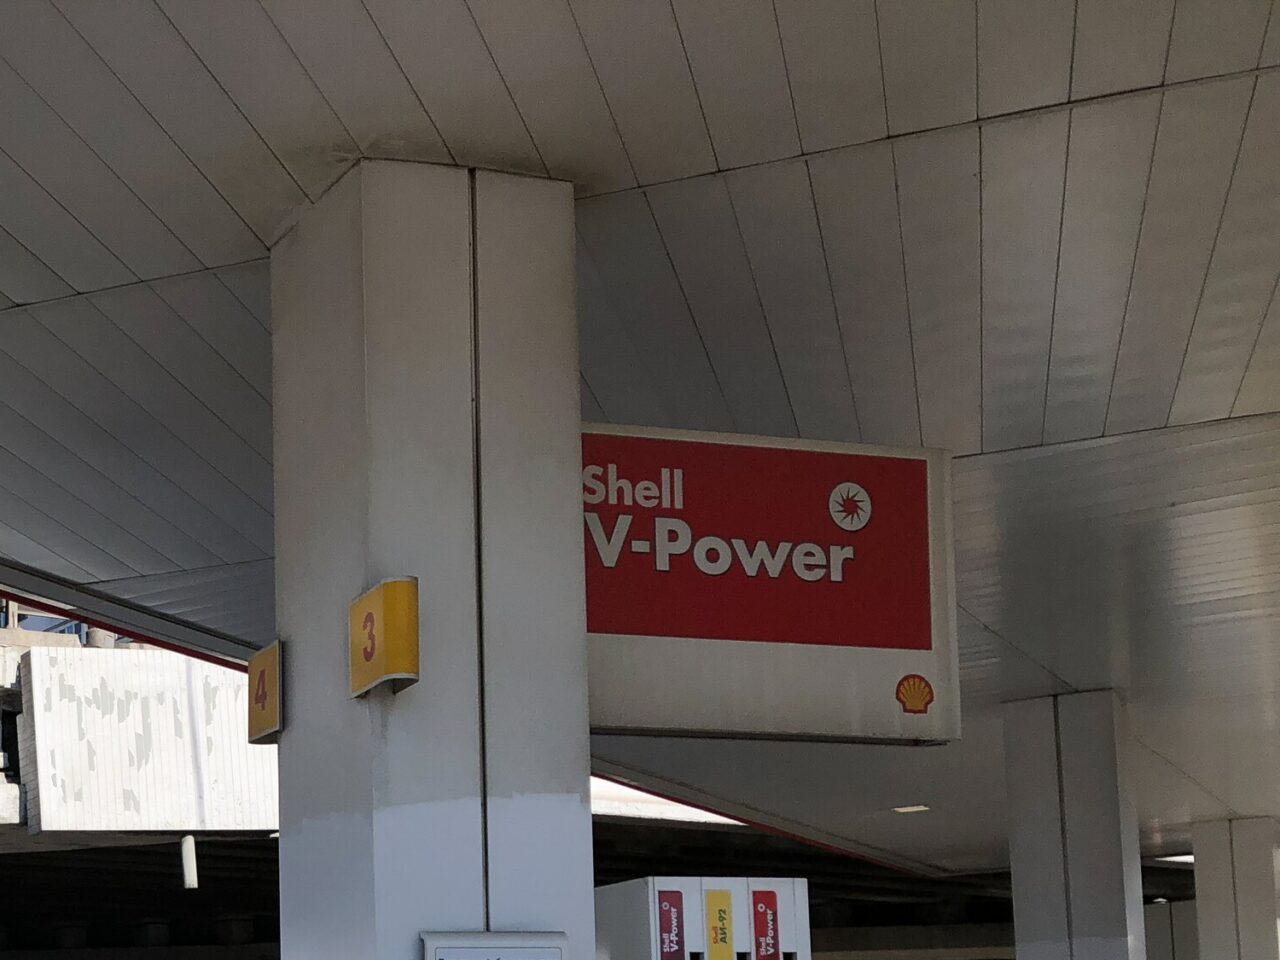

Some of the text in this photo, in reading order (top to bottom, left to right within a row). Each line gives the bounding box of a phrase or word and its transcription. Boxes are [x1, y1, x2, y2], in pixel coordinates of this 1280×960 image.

[581, 463, 684, 509] Shell
[583, 510, 854, 582] V-Power
[362, 611, 376, 662] 3
[254, 668, 268, 711] 4
[661, 933, 670, 952] Shell
[669, 906, 679, 952] V-Power
[758, 937, 767, 956] Shell
[766, 908, 775, 955] V-Power
